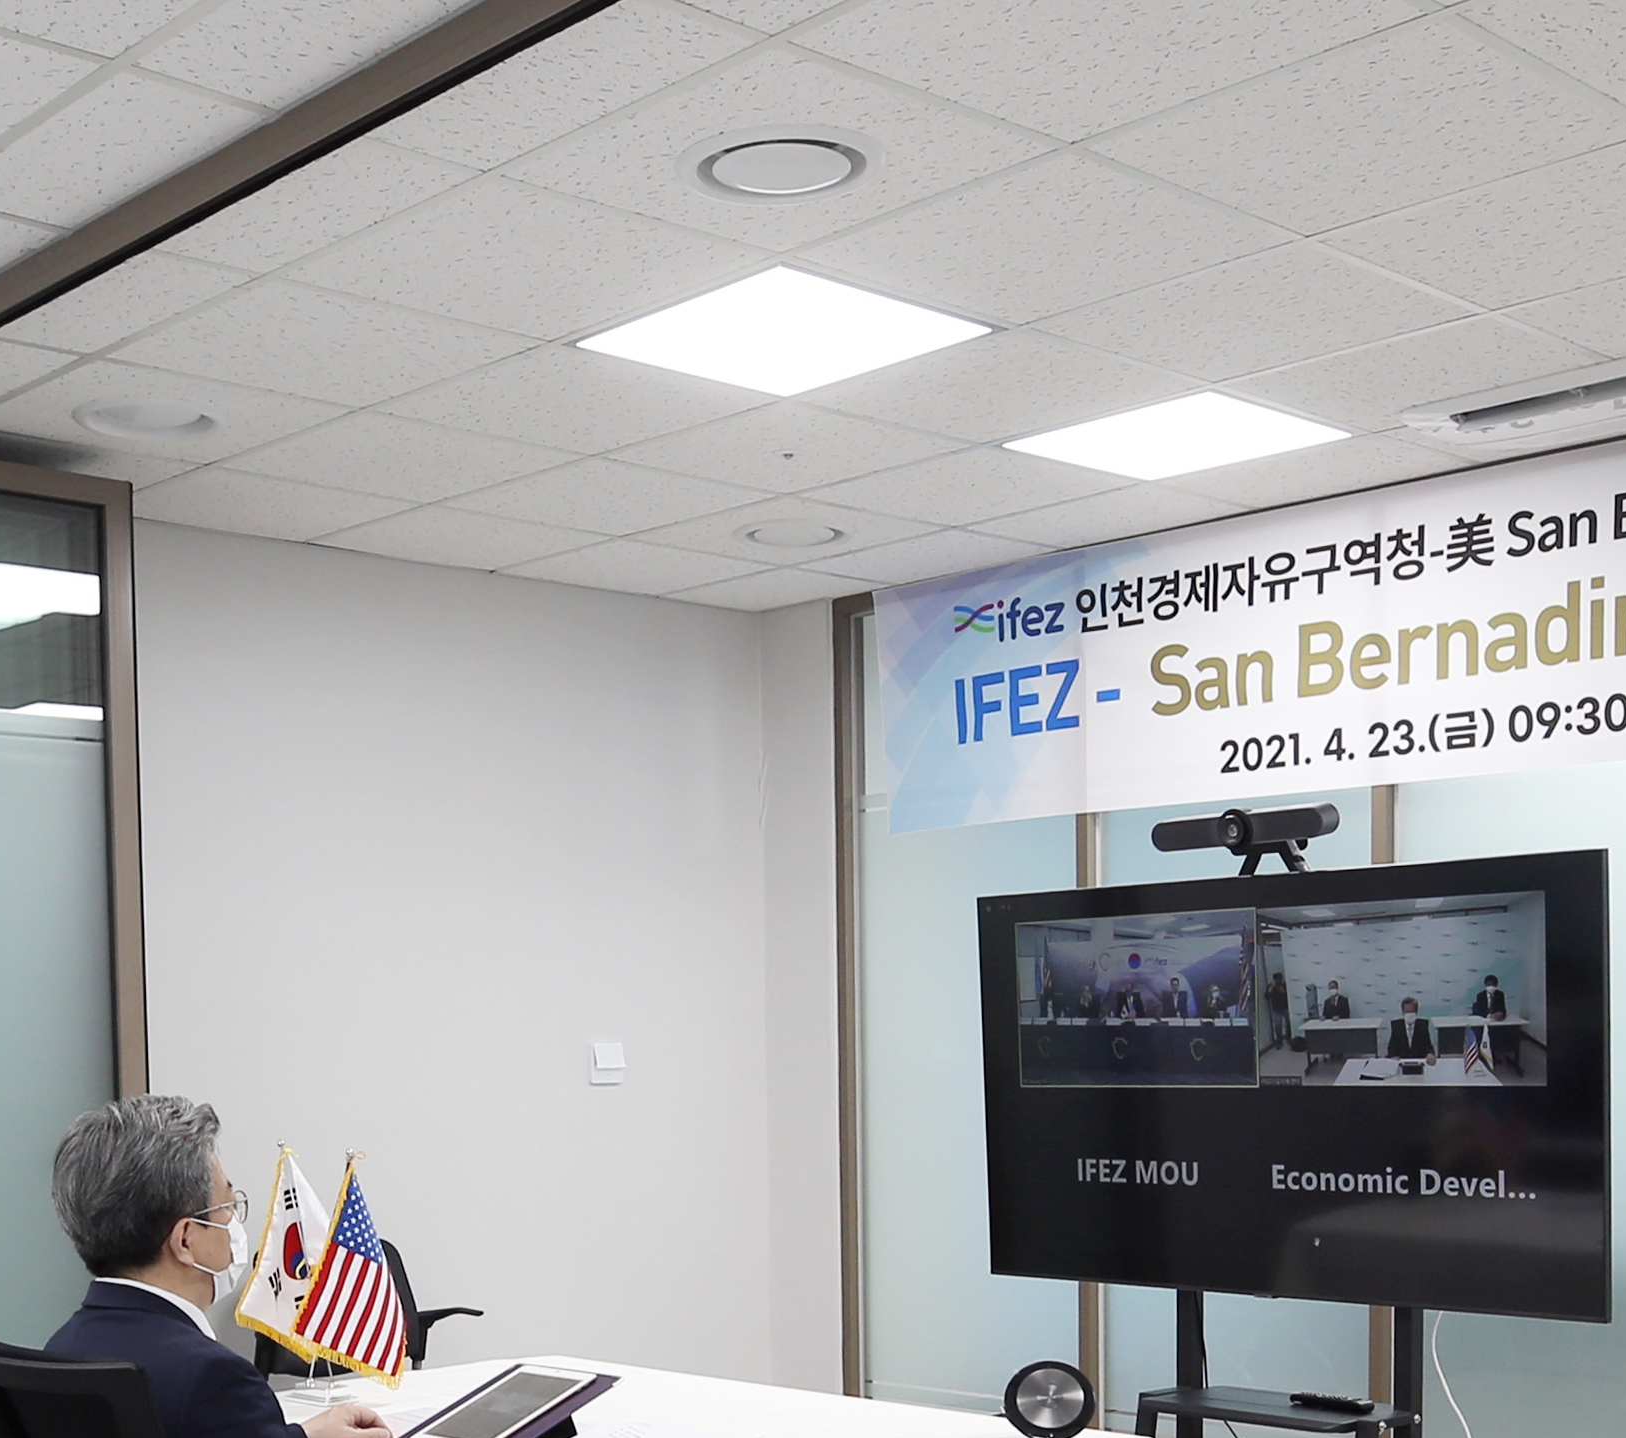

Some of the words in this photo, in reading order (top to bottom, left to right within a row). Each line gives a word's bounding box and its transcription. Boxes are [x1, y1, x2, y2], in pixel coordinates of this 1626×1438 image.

[996, 599, 1065, 643] ifez
[1507, 510, 1598, 557] San
[954, 658, 1080, 745] IFEZ
[1150, 643, 1274, 716] San
[1220, 732, 1312, 774] 2021.
[1323, 727, 1355, 762] 4.
[1368, 708, 1495, 759] 23.(금)
[1077, 1158, 1127, 1183] IFEZ
[1134, 1160, 1200, 1186] MOU
[1271, 1163, 1409, 1195] Economic
[1419, 1169, 1537, 1200] Devel...
